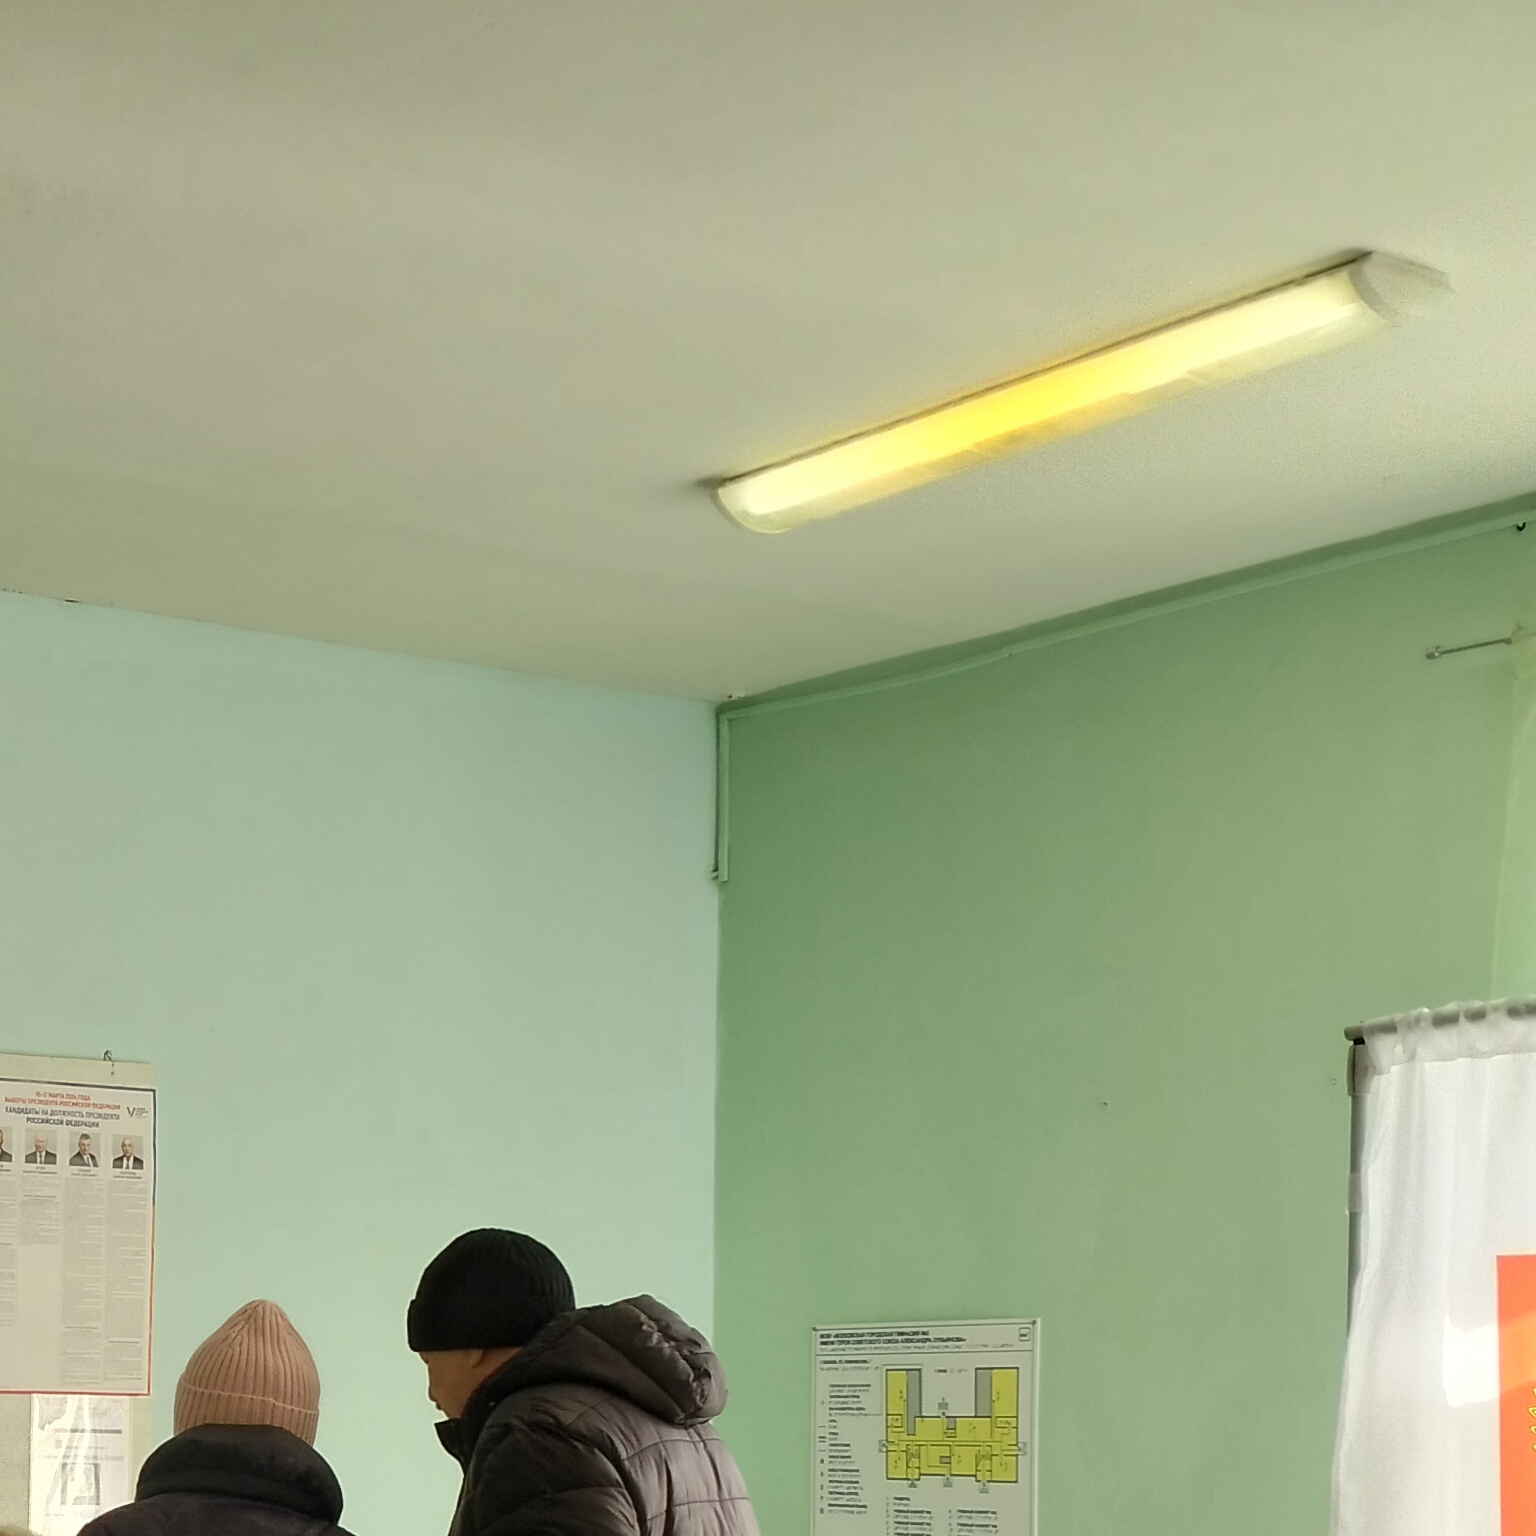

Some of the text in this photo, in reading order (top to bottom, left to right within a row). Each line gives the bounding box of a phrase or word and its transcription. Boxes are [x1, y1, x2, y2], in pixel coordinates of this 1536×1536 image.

[5, 1106, 40, 1115] КАНДИДАТЫ
[49, 1109, 85, 1119] ДОЛЖНОСТЬ
[85, 1111, 120, 1120] ПРЕЗИДЕНТА
[26, 1116, 100, 1128] РОССИЙСКОЙ ФЕДЕРАЦИИ
